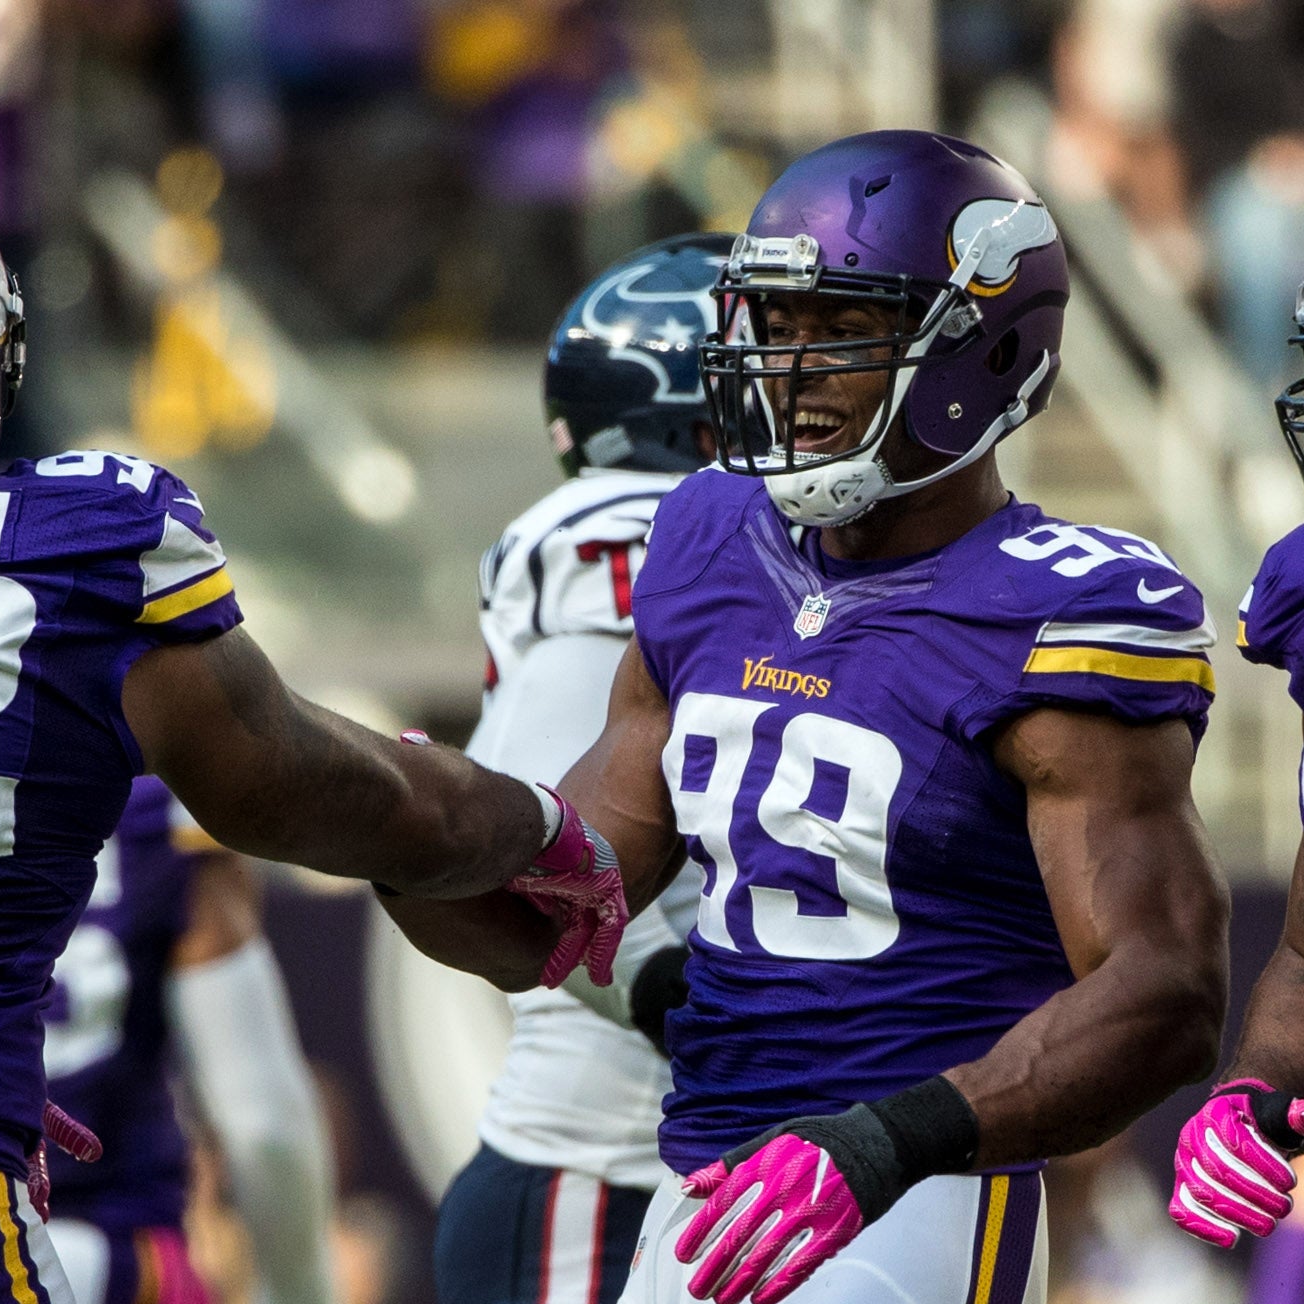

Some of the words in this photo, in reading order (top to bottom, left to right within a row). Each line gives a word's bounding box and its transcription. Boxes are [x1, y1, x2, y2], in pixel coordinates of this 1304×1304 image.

[799, 612, 820, 631] NFL
[741, 651, 832, 700] VIKINGS
[661, 691, 904, 961] 99
